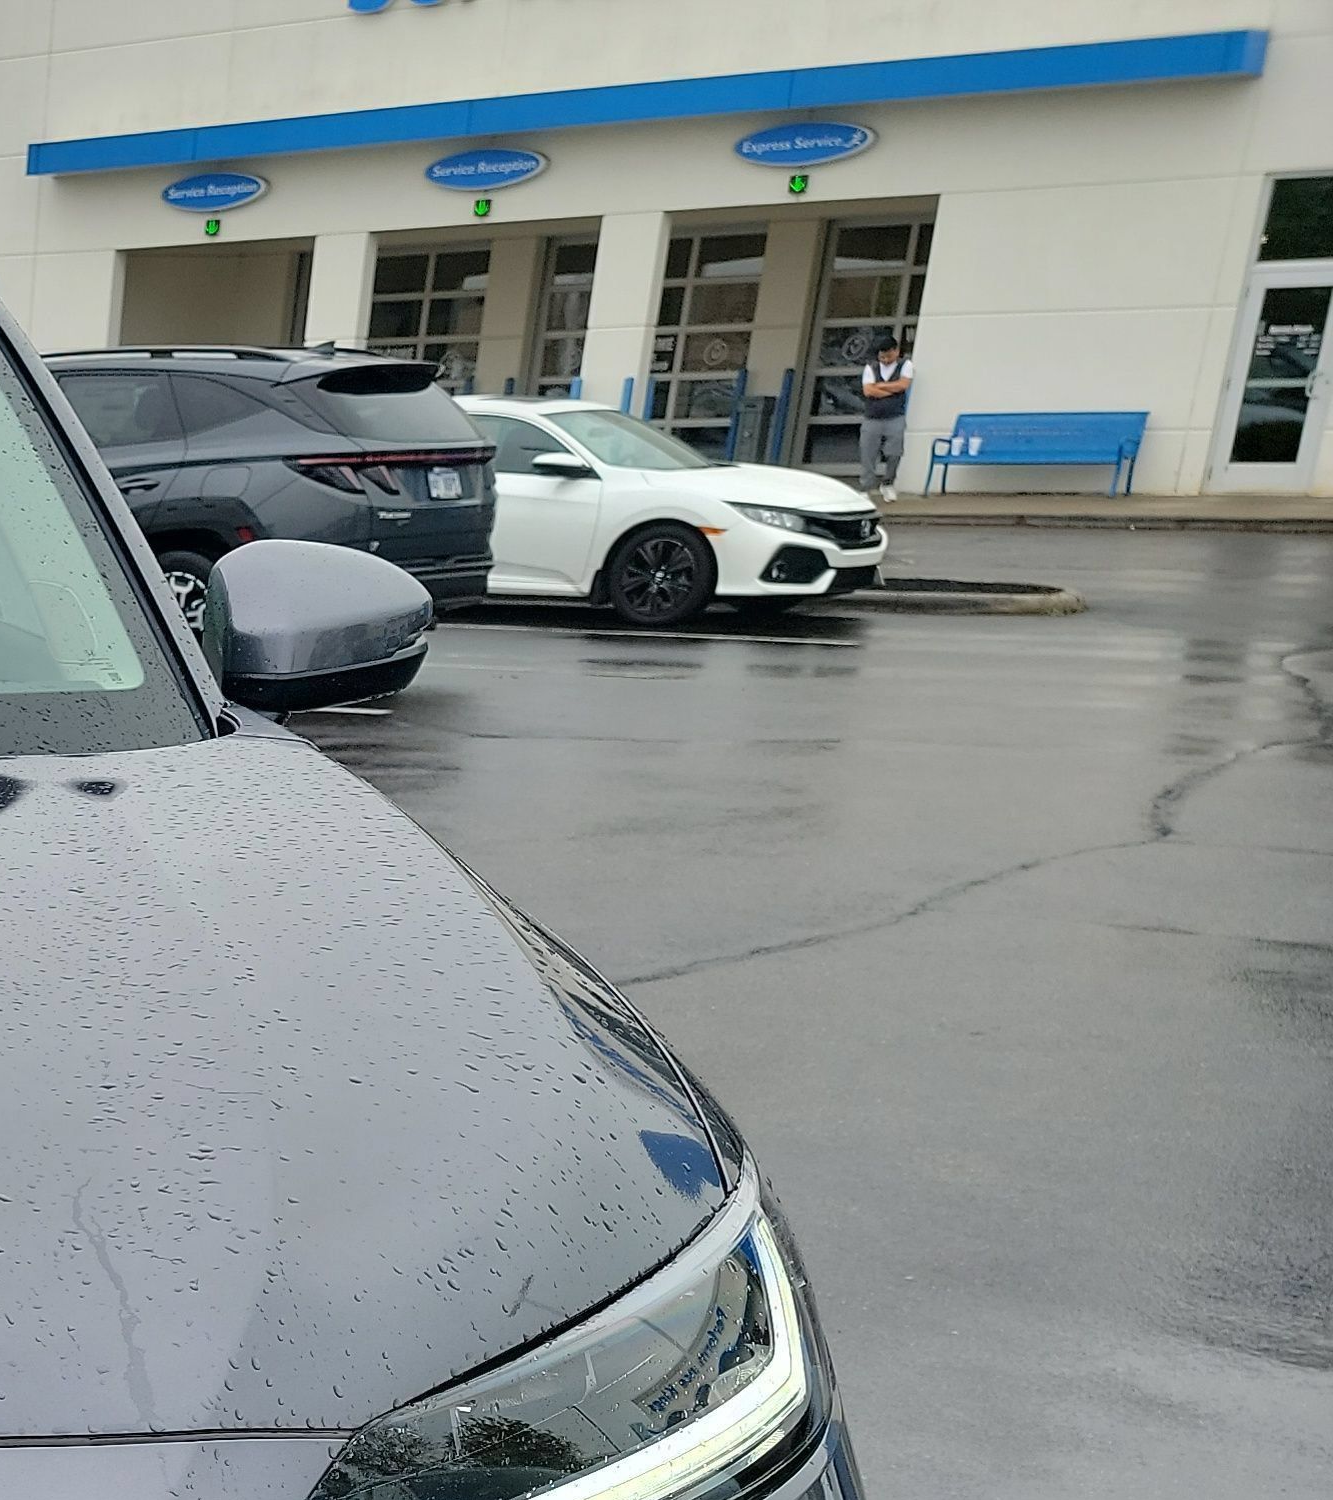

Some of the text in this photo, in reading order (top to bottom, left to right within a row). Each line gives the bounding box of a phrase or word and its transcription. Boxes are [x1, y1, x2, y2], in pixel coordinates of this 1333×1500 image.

[741, 136, 843, 155] Express Service
[432, 159, 537, 177] Service Reception
[167, 188, 206, 200] Service
